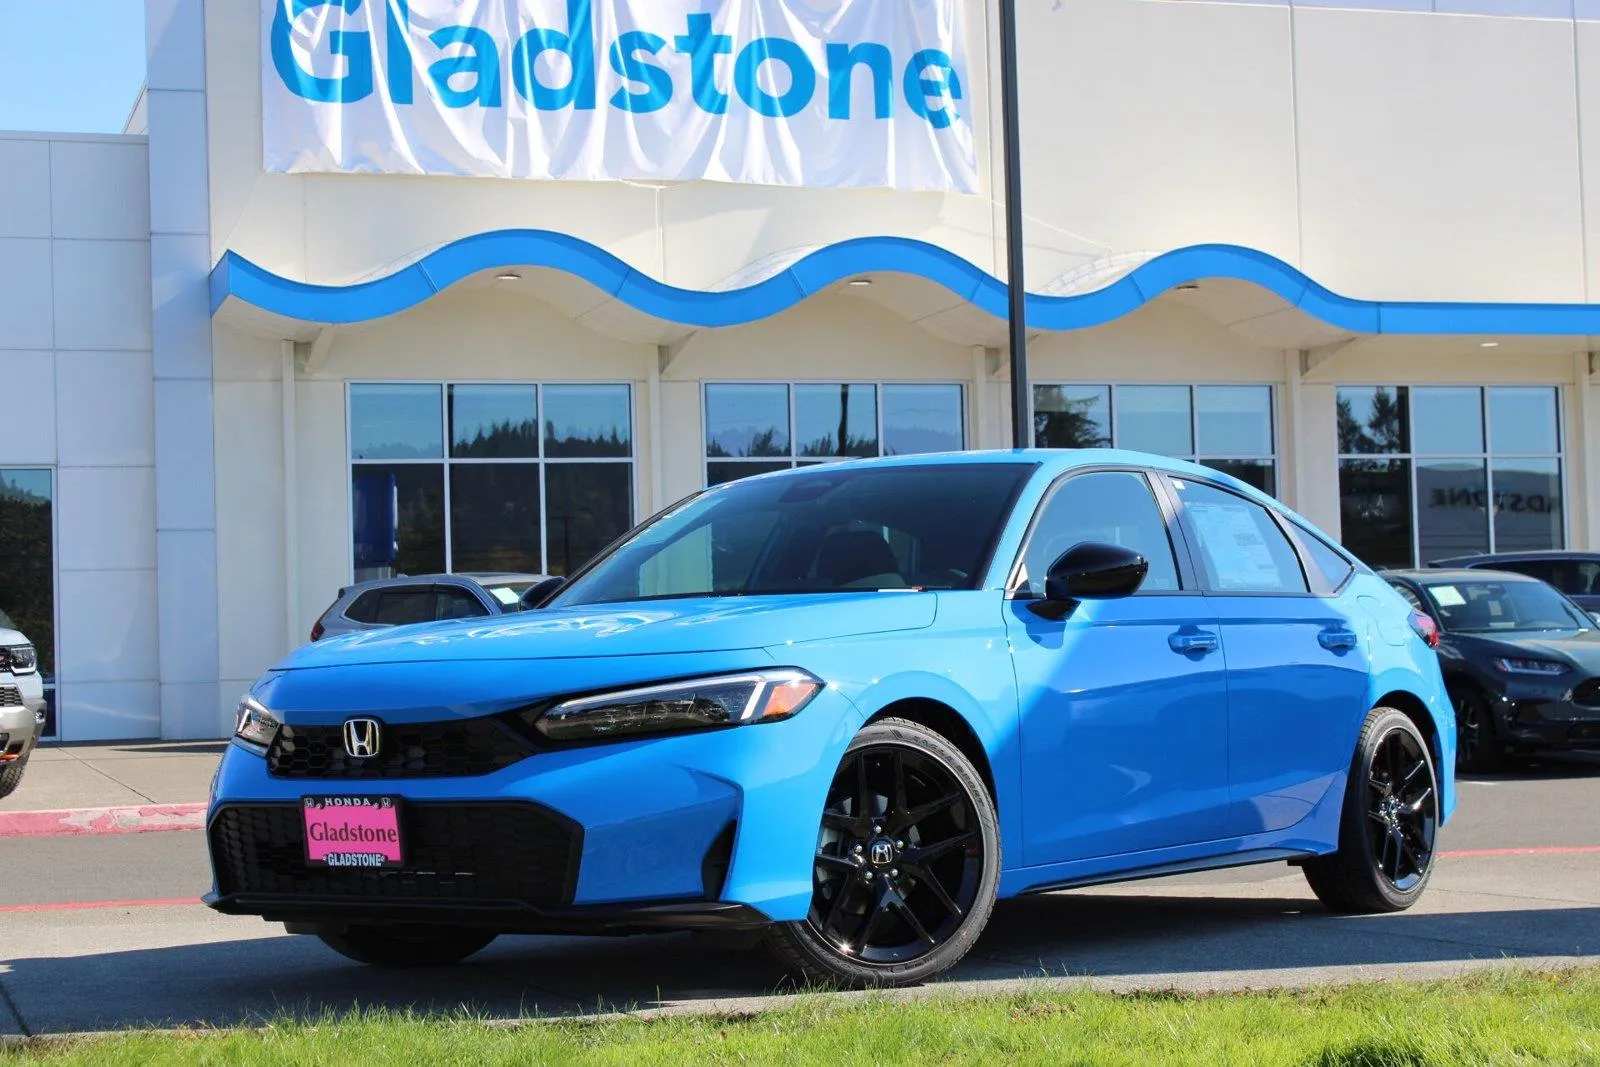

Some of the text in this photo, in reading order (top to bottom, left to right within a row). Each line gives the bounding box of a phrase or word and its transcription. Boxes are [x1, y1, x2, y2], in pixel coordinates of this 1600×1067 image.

[269, 0, 963, 129] Gladstone
[325, 797, 371, 806] HONDA
[309, 821, 397, 842] Gladstone
[328, 853, 382, 866] GLADSTONE
